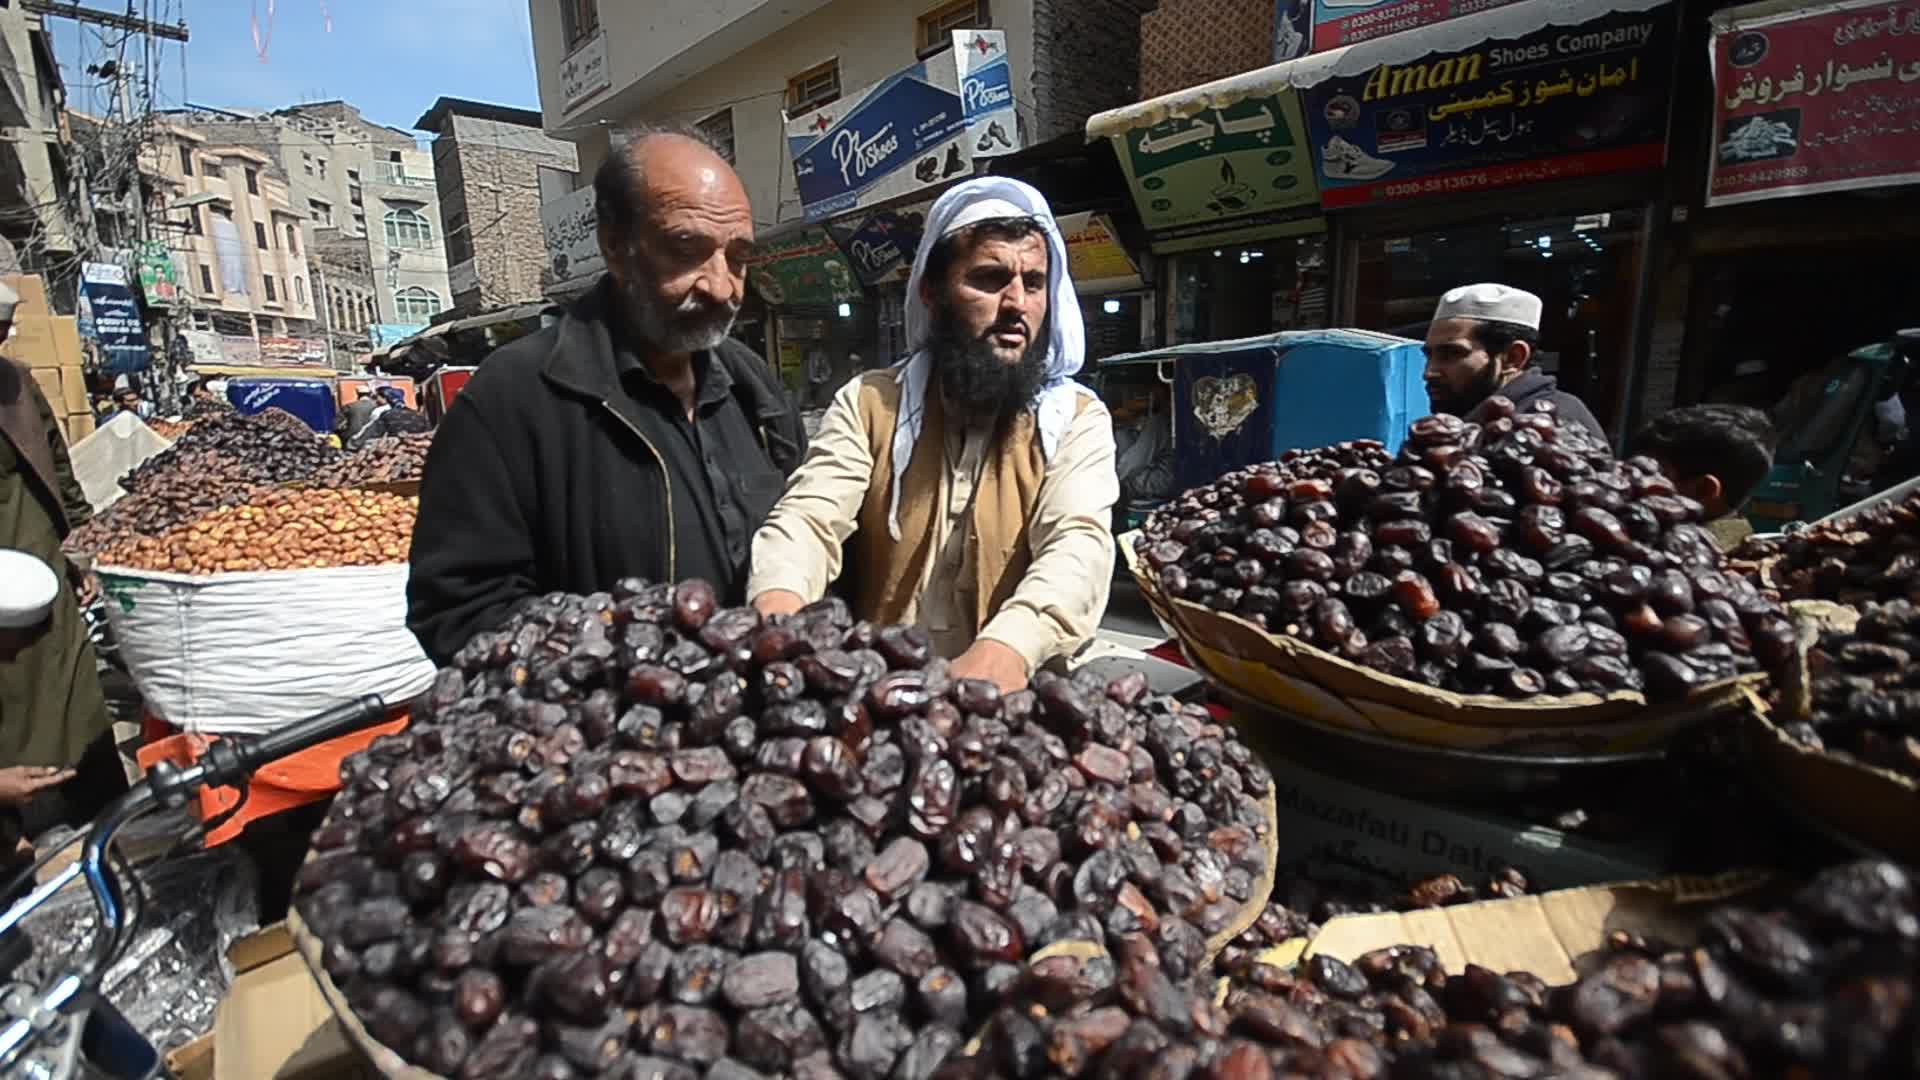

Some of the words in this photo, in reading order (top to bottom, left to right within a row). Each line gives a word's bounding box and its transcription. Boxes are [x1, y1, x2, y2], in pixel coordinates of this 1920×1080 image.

[1362, 51, 1485, 103] Aman
[1488, 40, 1550, 67] Shoes
[1555, 22, 1655, 54] Company
[1576, 55, 1641, 97] امان
[1804, 50, 1894, 97] نسوار
[1724, 63, 1806, 110] فروش
[865, 134, 899, 169] Shoes
[1421, 829, 1512, 878] Date
